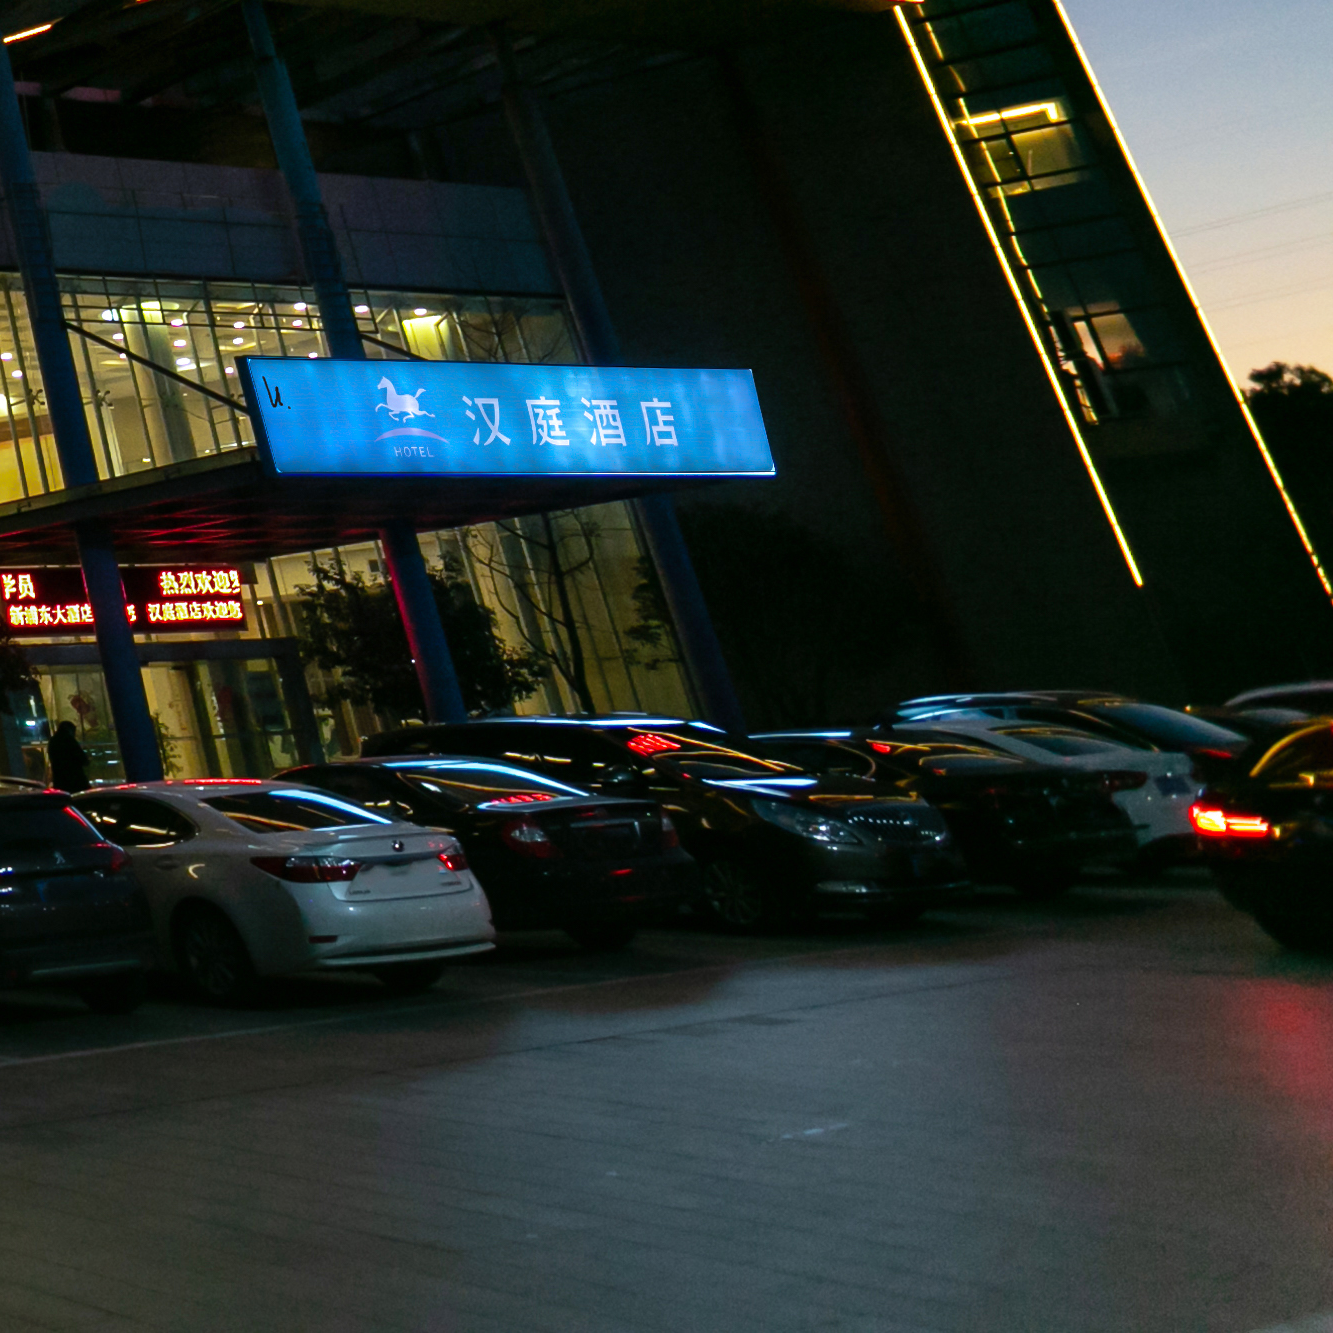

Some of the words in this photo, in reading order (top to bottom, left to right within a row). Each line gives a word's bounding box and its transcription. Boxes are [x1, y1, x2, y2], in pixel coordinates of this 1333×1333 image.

[462, 395, 679, 447] 汉庭酒店
[394, 446, 435, 458] HOTEL
